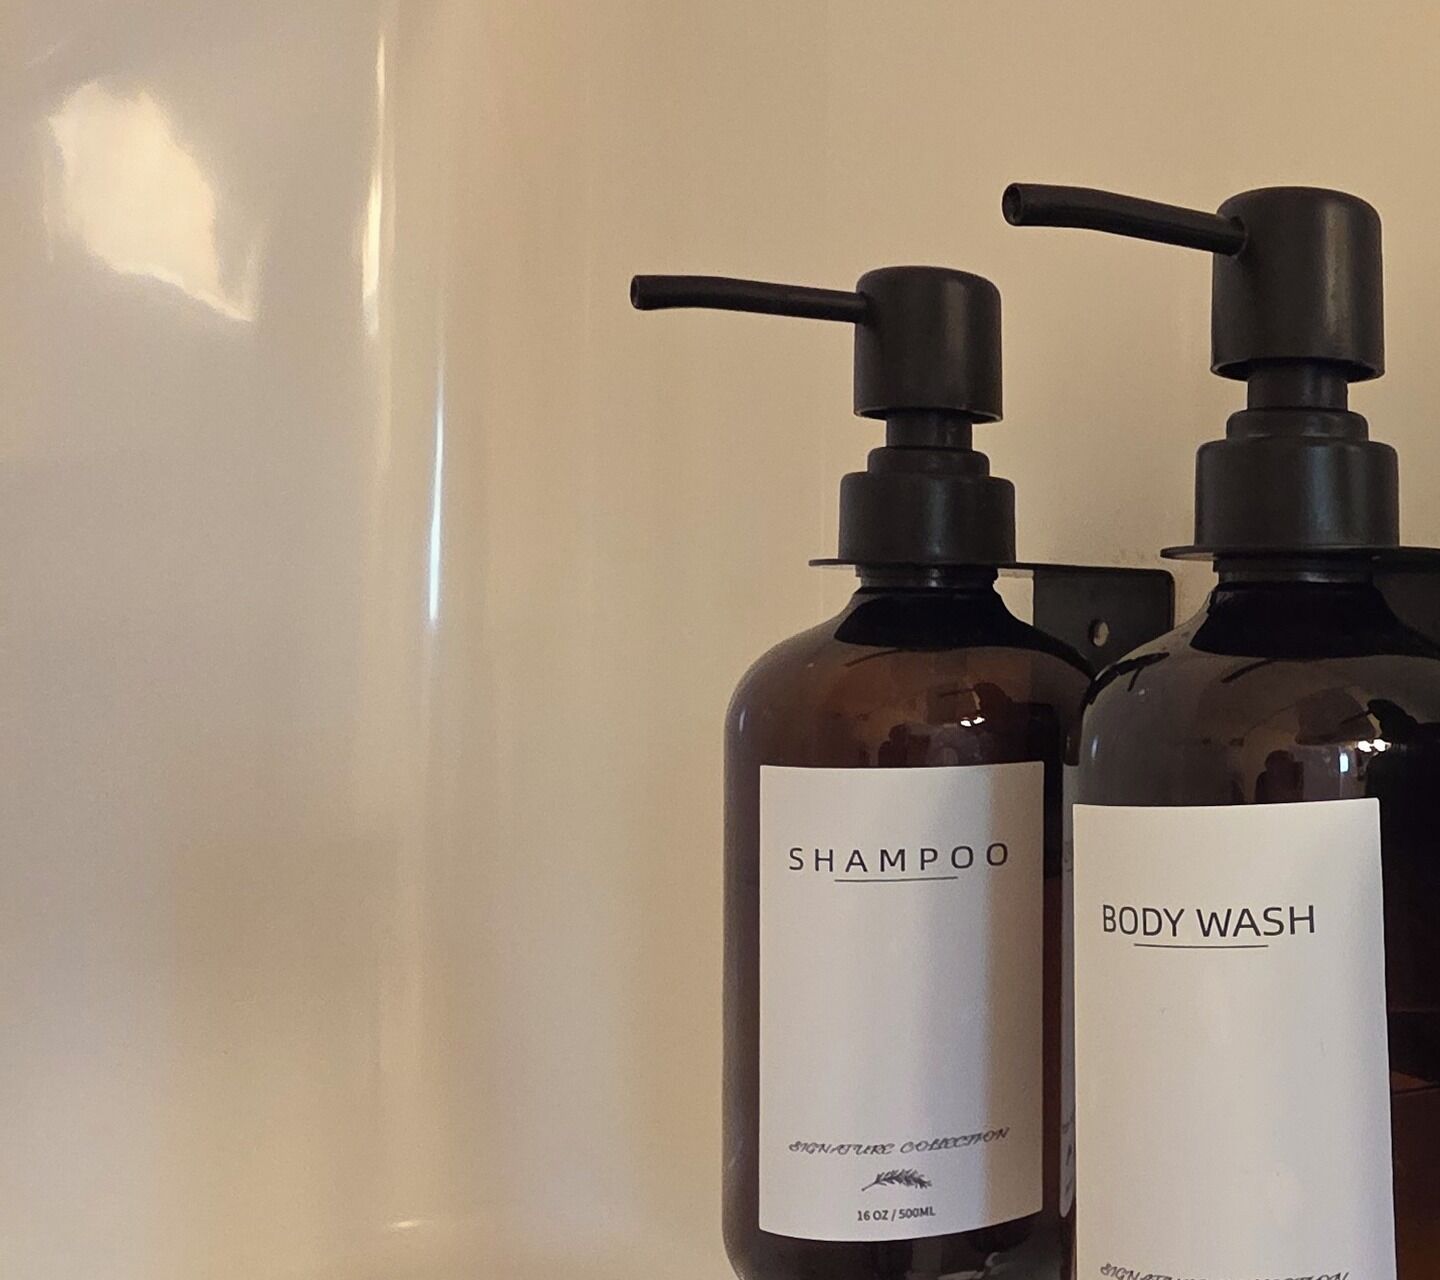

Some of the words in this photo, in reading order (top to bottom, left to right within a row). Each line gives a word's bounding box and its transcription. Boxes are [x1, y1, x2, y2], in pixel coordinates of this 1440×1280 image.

[788, 842, 1009, 873] SHAMPOO
[1102, 903, 1185, 938] BODY
[1195, 904, 1316, 938] WASH
[788, 1140, 896, 1156] SIGNATURE
[899, 1127, 1010, 1154] COLLECTION
[857, 1209, 871, 1222] 16
[872, 1209, 889, 1221] OZ
[890, 1208, 897, 1222] /
[898, 1205, 936, 1220] 500ML
